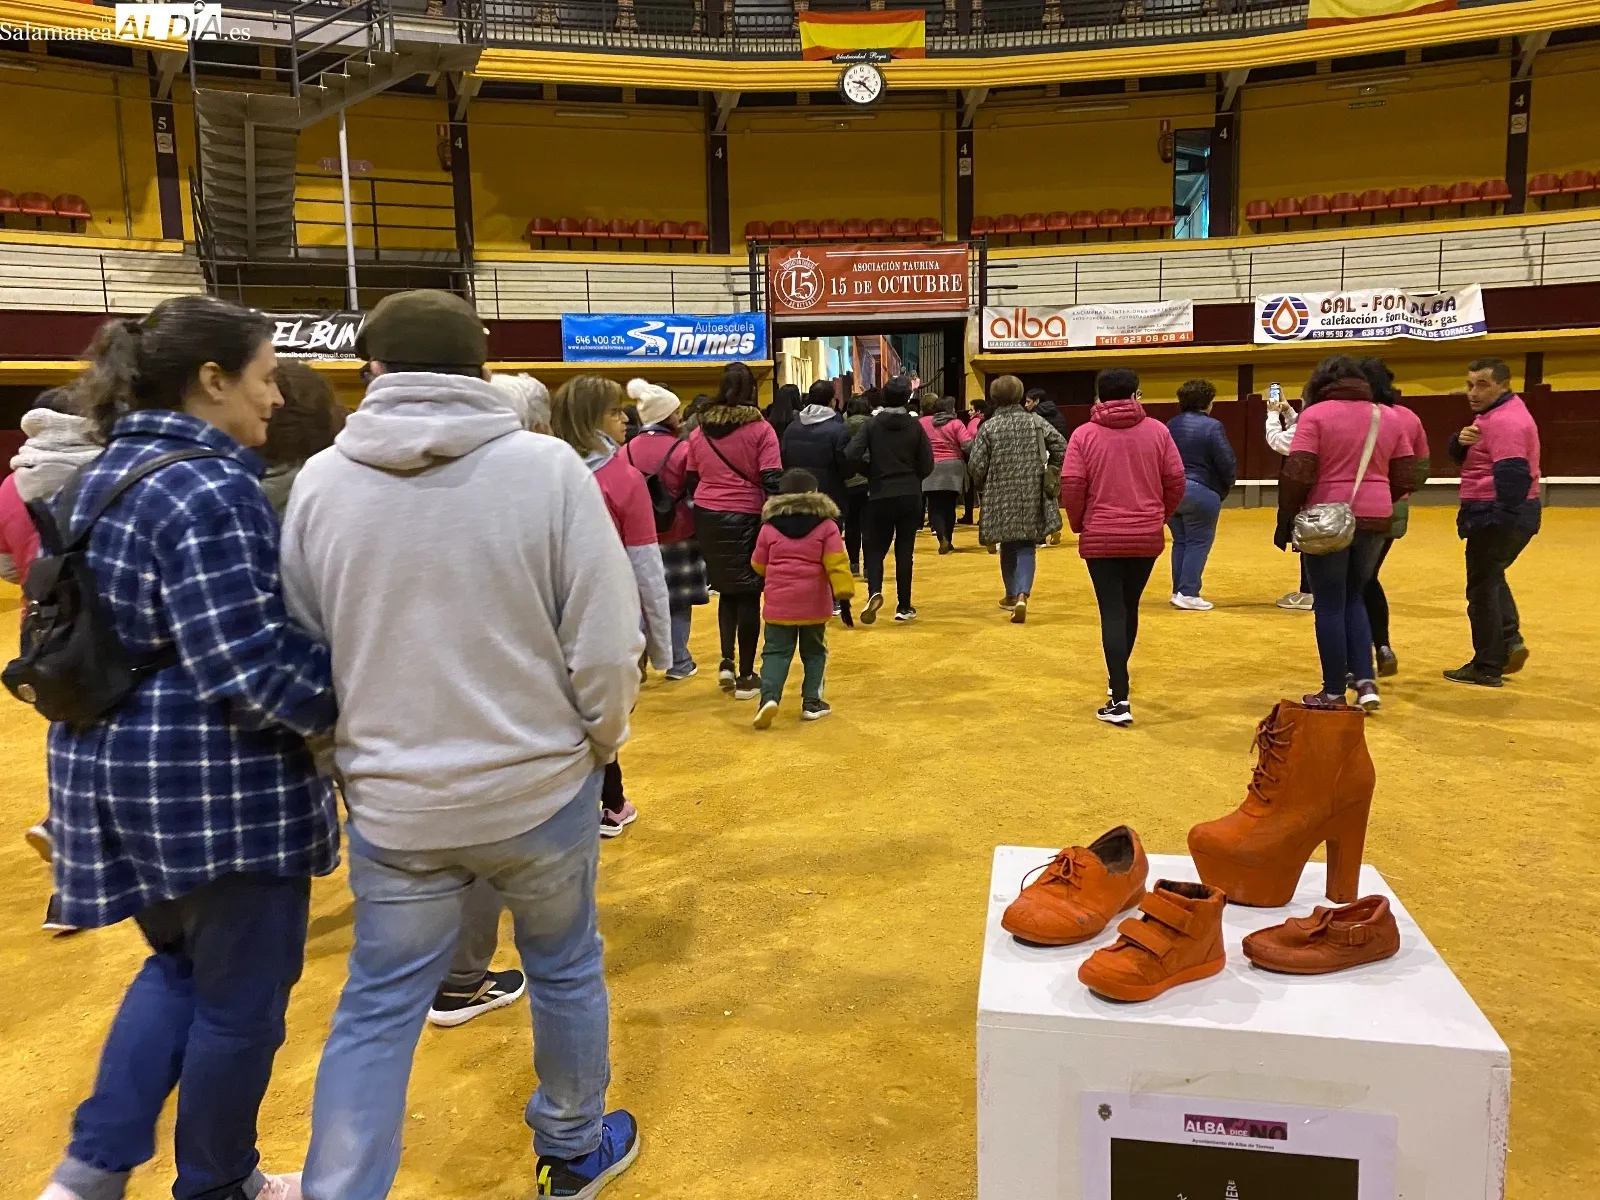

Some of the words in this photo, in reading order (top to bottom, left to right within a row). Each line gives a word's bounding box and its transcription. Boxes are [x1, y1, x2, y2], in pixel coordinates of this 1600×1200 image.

[1515, 94, 1525, 107] 4
[158, 116, 167, 130] 5
[1219, 127, 1228, 139] 4
[455, 136, 463, 149] 4
[960, 143, 968, 155] 4
[714, 146, 723, 159] 4
[852, 260, 901, 272] ASOCIACIÓN
[903, 260, 940, 270] TAURINA
[788, 270, 815, 299] 15
[830, 277, 847, 296] 15
[854, 280, 873, 294] DE
[878, 273, 962, 294] OCTUBRE
[989, 307, 1067, 339] alba
[1320, 310, 1378, 326] calefacción
[1440, 314, 1457, 328] gas
[271, 319, 309, 347] EL
[695, 320, 755, 333] Autoescuela
[1361, 328, 1375, 337] 638
[1375, 327, 1385, 336] 95
[1409, 327, 1428, 338] ALBA
[1429, 330, 1439, 338] DE
[1439, 324, 1474, 337] TORMES
[575, 335, 591, 345] 646
[592, 335, 609, 345] 400
[611, 335, 626, 345] 274
[1099, 336, 1120, 345] Telf:
[1123, 335, 1142, 345] 923
[1145, 334, 1159, 343] 08
[1161, 333, 1176, 342] 08
[1179, 332, 1190, 341] 41
[1312, 329, 1325, 338] 638
[1326, 329, 1336, 338] 95
[666, 326, 756, 356] Tormes
[1033, 339, 1068, 347] GRANITOS
[1185, 1120, 1227, 1136] ALBA
[1230, 1129, 1249, 1137] DICE
[1250, 1124, 1288, 1141] NO
